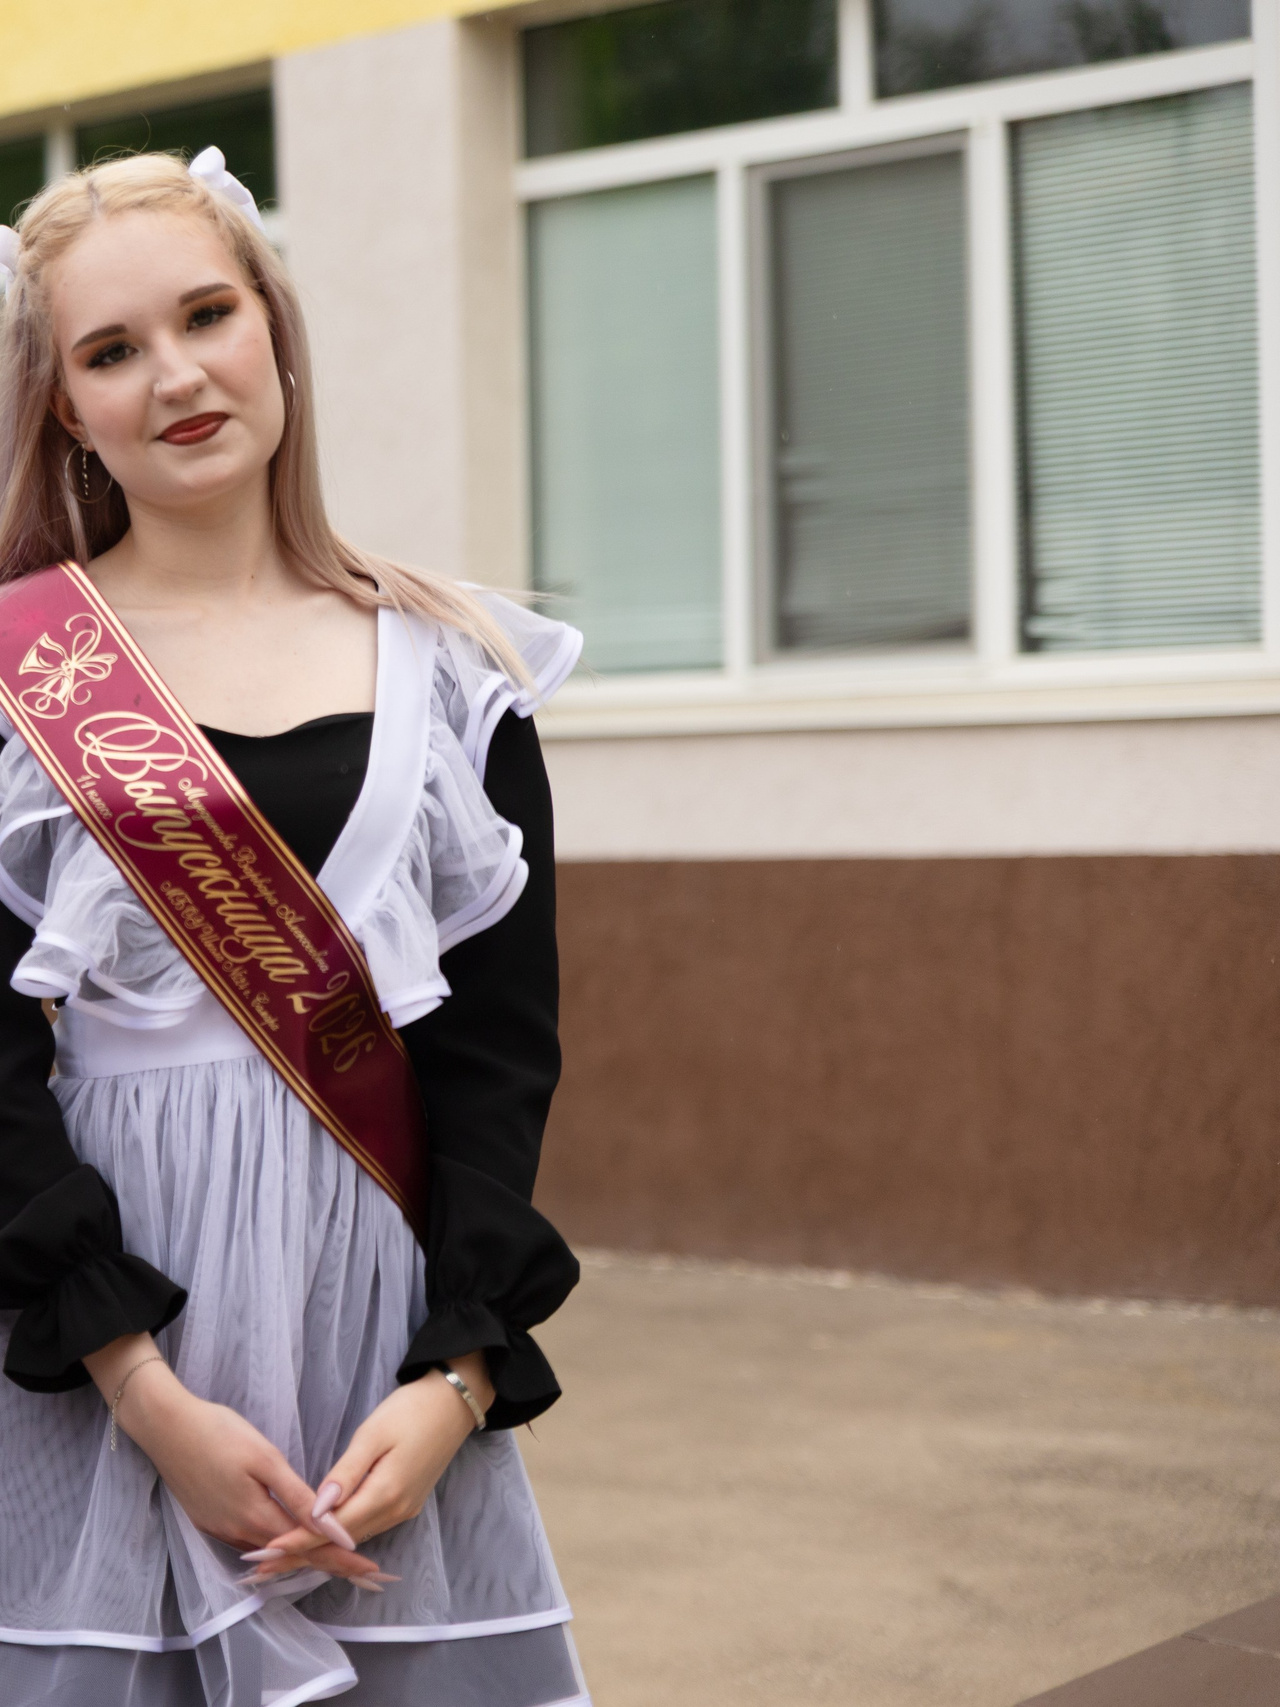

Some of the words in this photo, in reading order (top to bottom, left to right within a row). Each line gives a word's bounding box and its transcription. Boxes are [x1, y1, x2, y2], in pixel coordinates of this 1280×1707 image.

[76, 775, 96, 789] 11
[86, 789, 113, 820] класс
[74, 711, 310, 983] Выпускница
[286, 971, 376, 1073] 2026
[232, 845, 279, 906] Варвара
